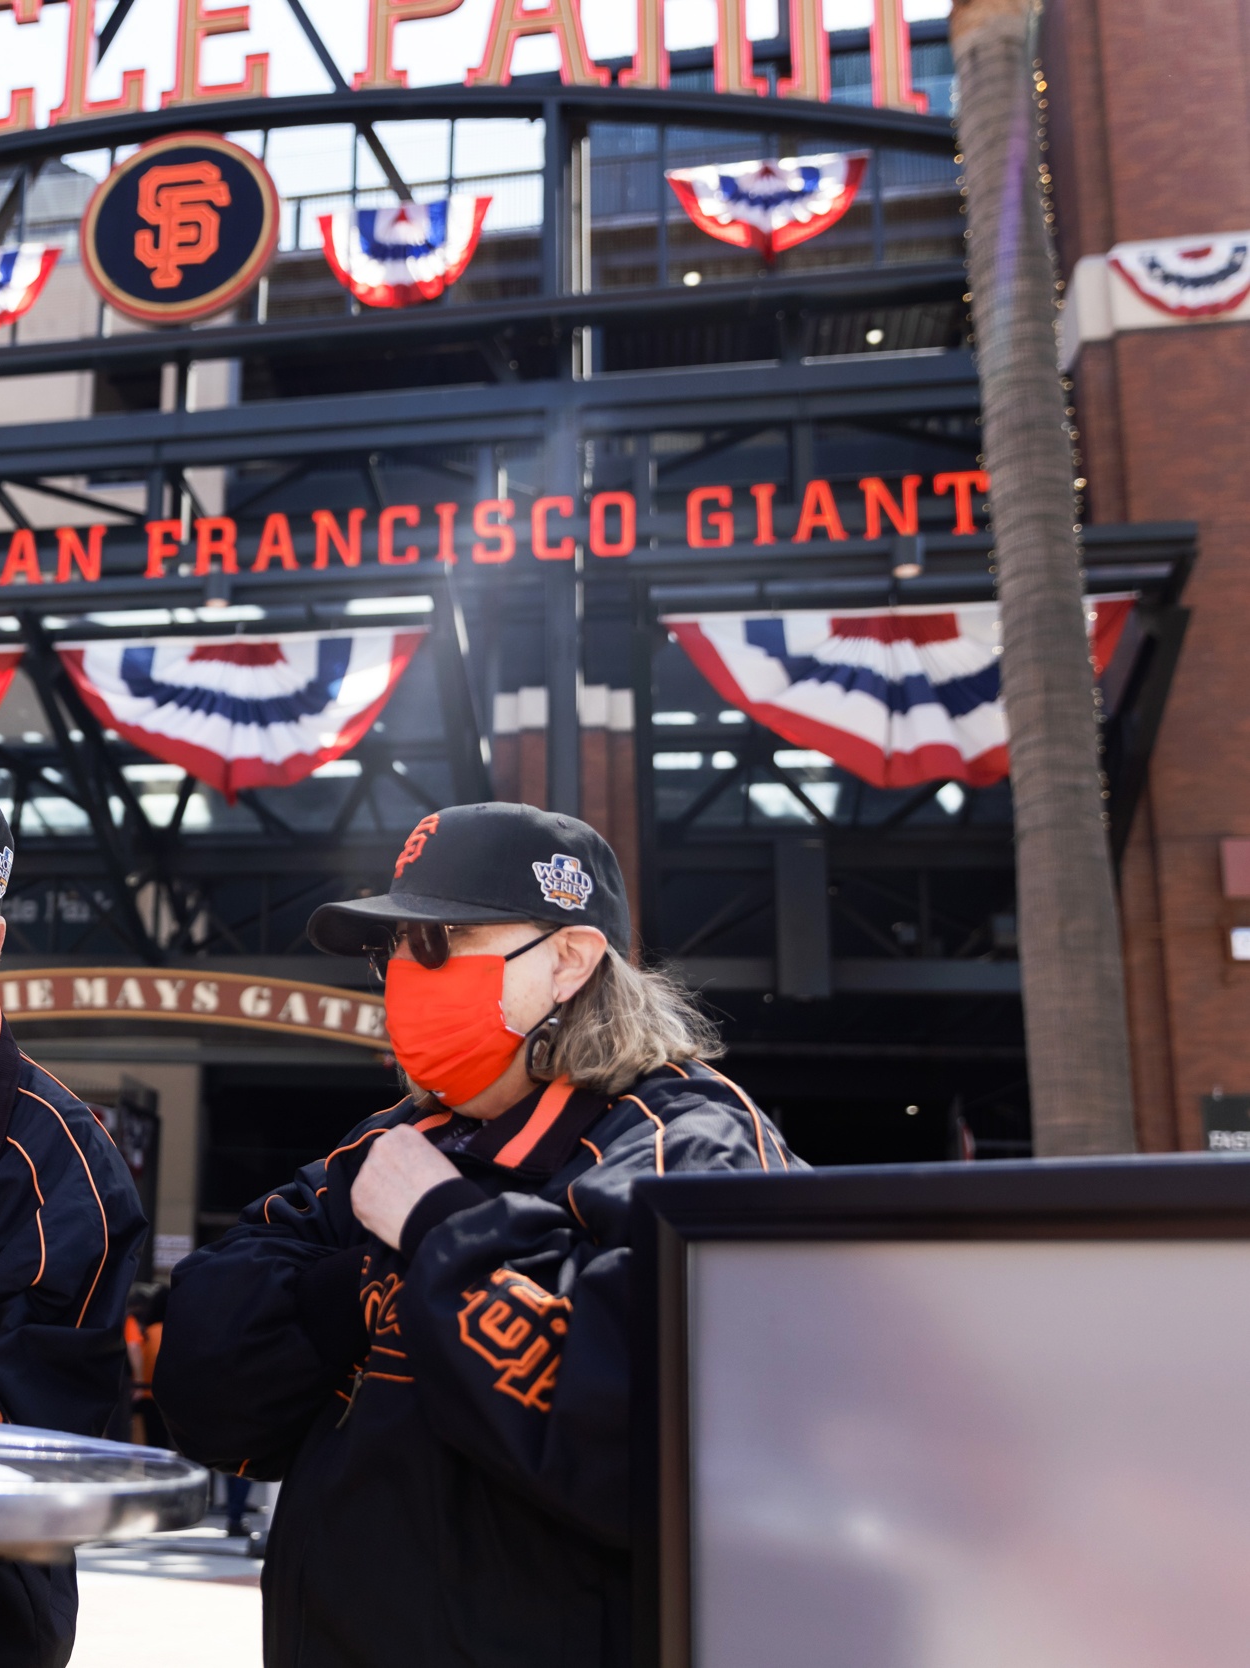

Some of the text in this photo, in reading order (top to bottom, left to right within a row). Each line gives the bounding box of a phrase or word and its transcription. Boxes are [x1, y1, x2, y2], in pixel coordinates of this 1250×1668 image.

[134, 159, 231, 289] SF
[144, 491, 637, 579] FRANCISCO
[686, 470, 991, 550] GIANT
[533, 863, 591, 891] WORLD
[543, 876, 586, 900] SERIES
[72, 977, 220, 1013] MAYS
[239, 985, 387, 1038] GATE
